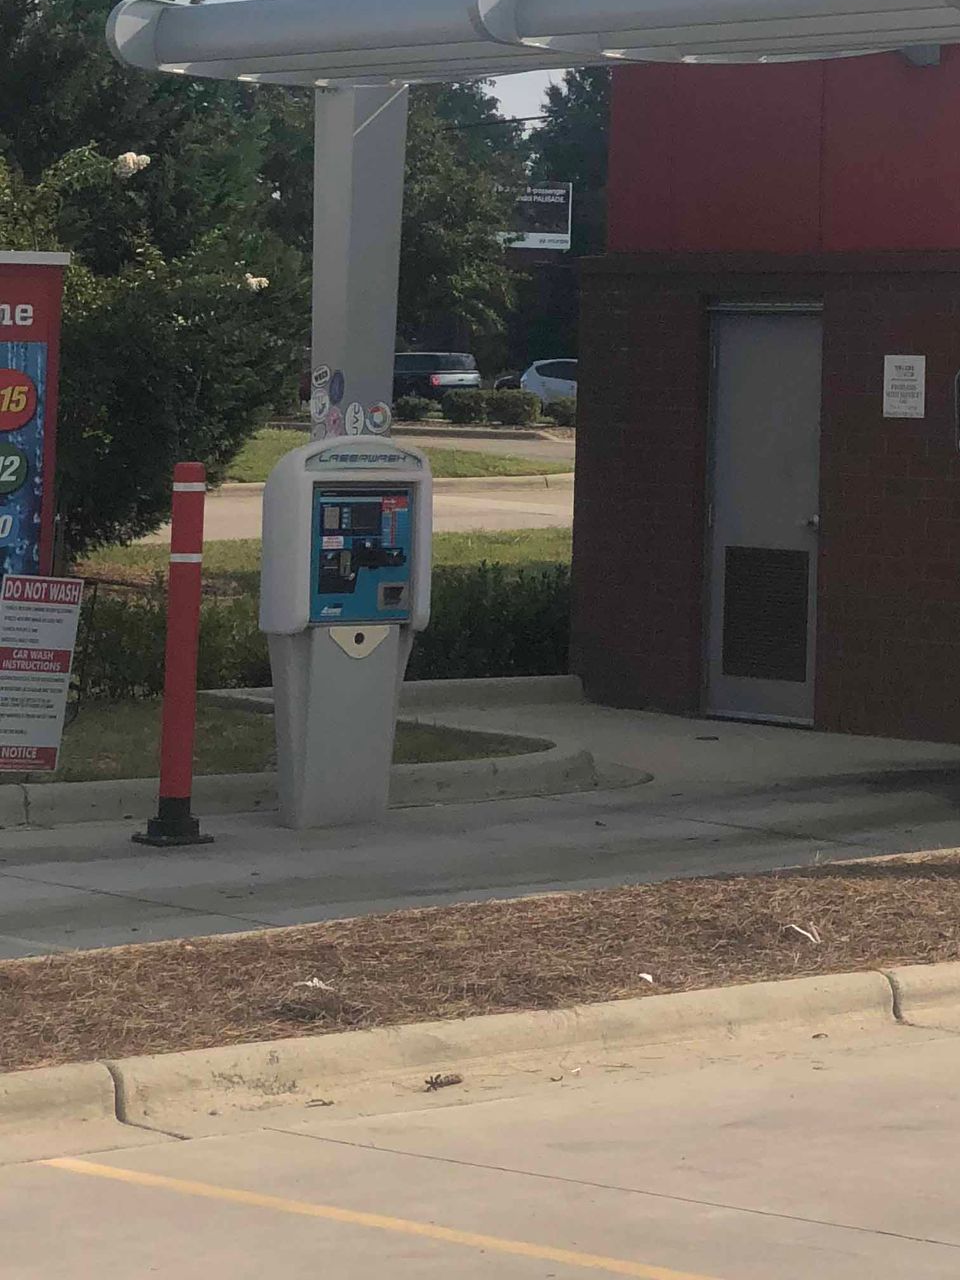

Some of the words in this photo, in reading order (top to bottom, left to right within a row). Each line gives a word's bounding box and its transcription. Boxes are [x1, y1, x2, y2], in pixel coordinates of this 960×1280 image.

[319, 454, 407, 463] LASERWASH
[5, 580, 21, 598] DO
[24, 583, 47, 600] NOT
[49, 584, 80, 603] WASH
[12, 649, 28, 659] CAR
[30, 650, 54, 660] WASH
[2, 660, 61, 671] INSTRUCTIONS
[1, 747, 37, 758] NOTICE
